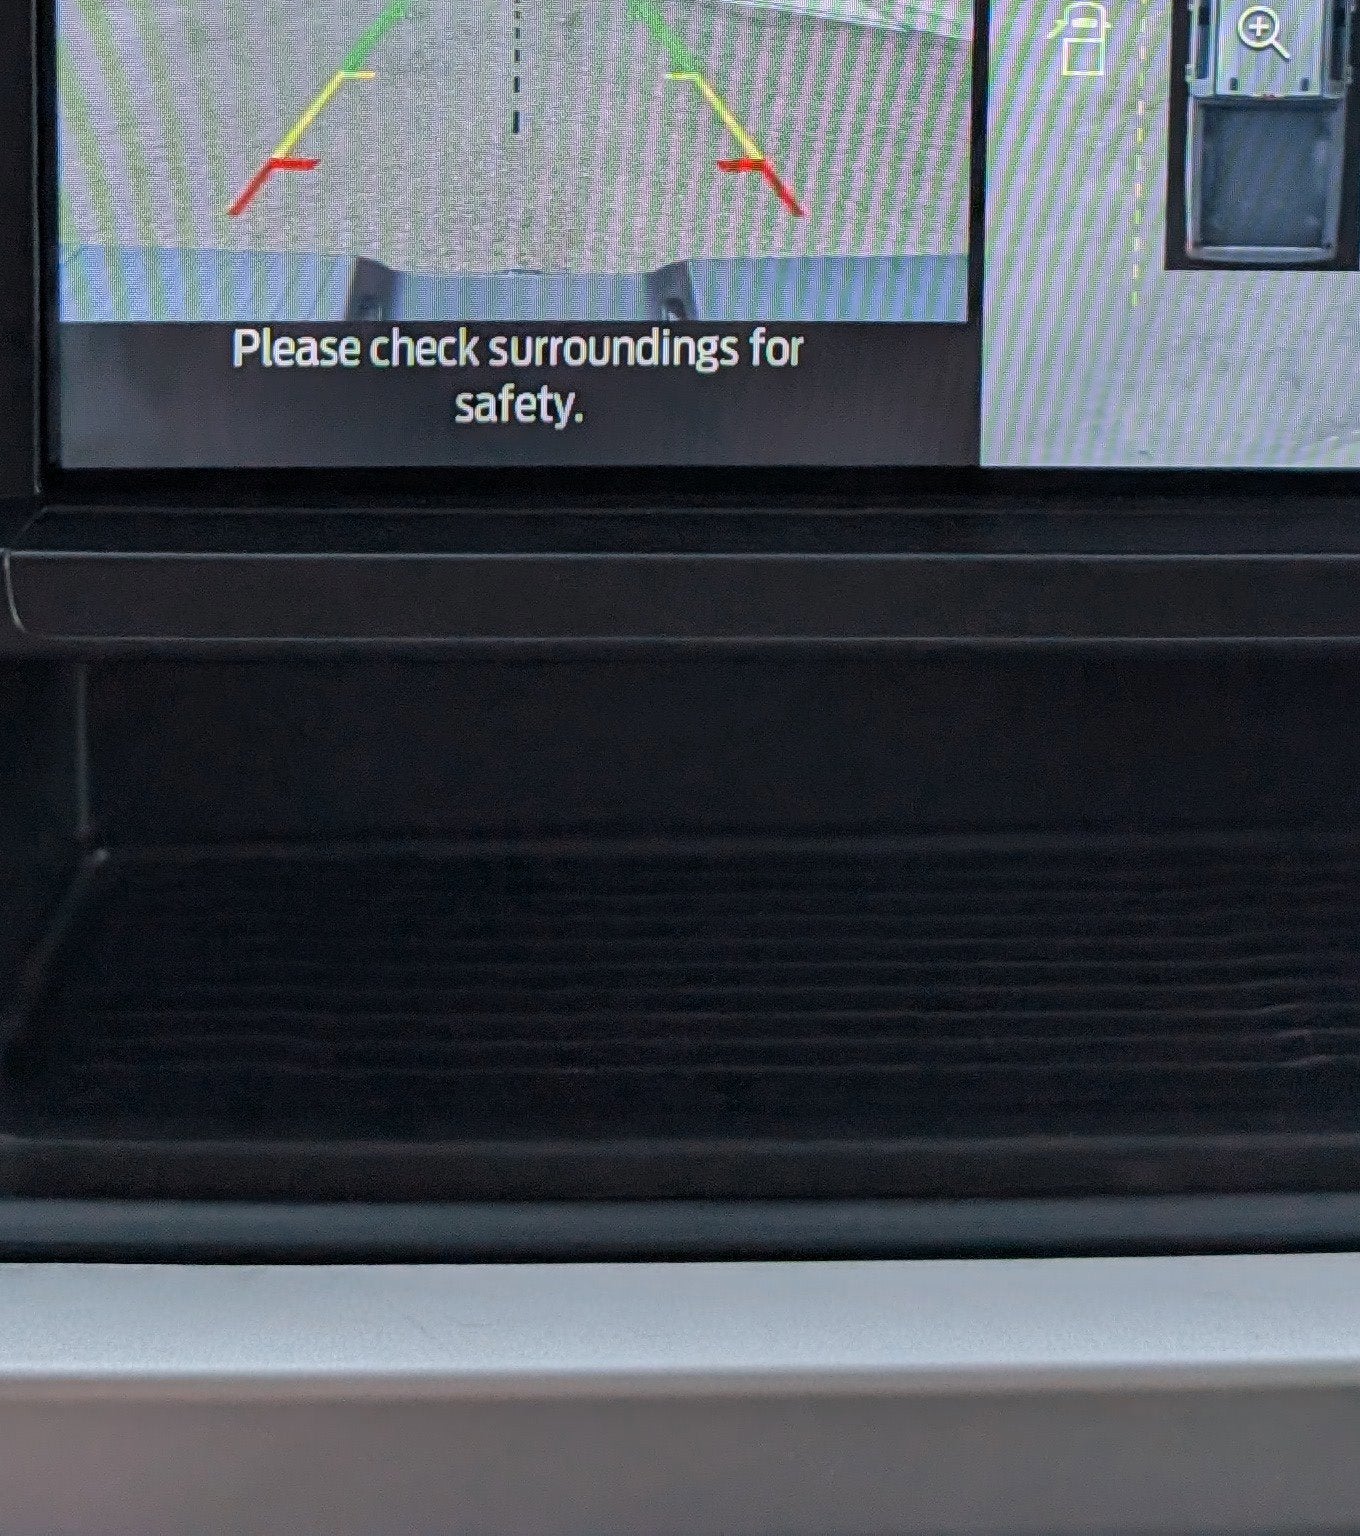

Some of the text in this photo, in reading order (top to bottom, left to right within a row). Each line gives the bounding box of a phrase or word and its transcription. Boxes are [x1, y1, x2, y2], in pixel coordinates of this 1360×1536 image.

[232, 326, 805, 374] Please check surroundings for
[454, 382, 584, 430] safety.
